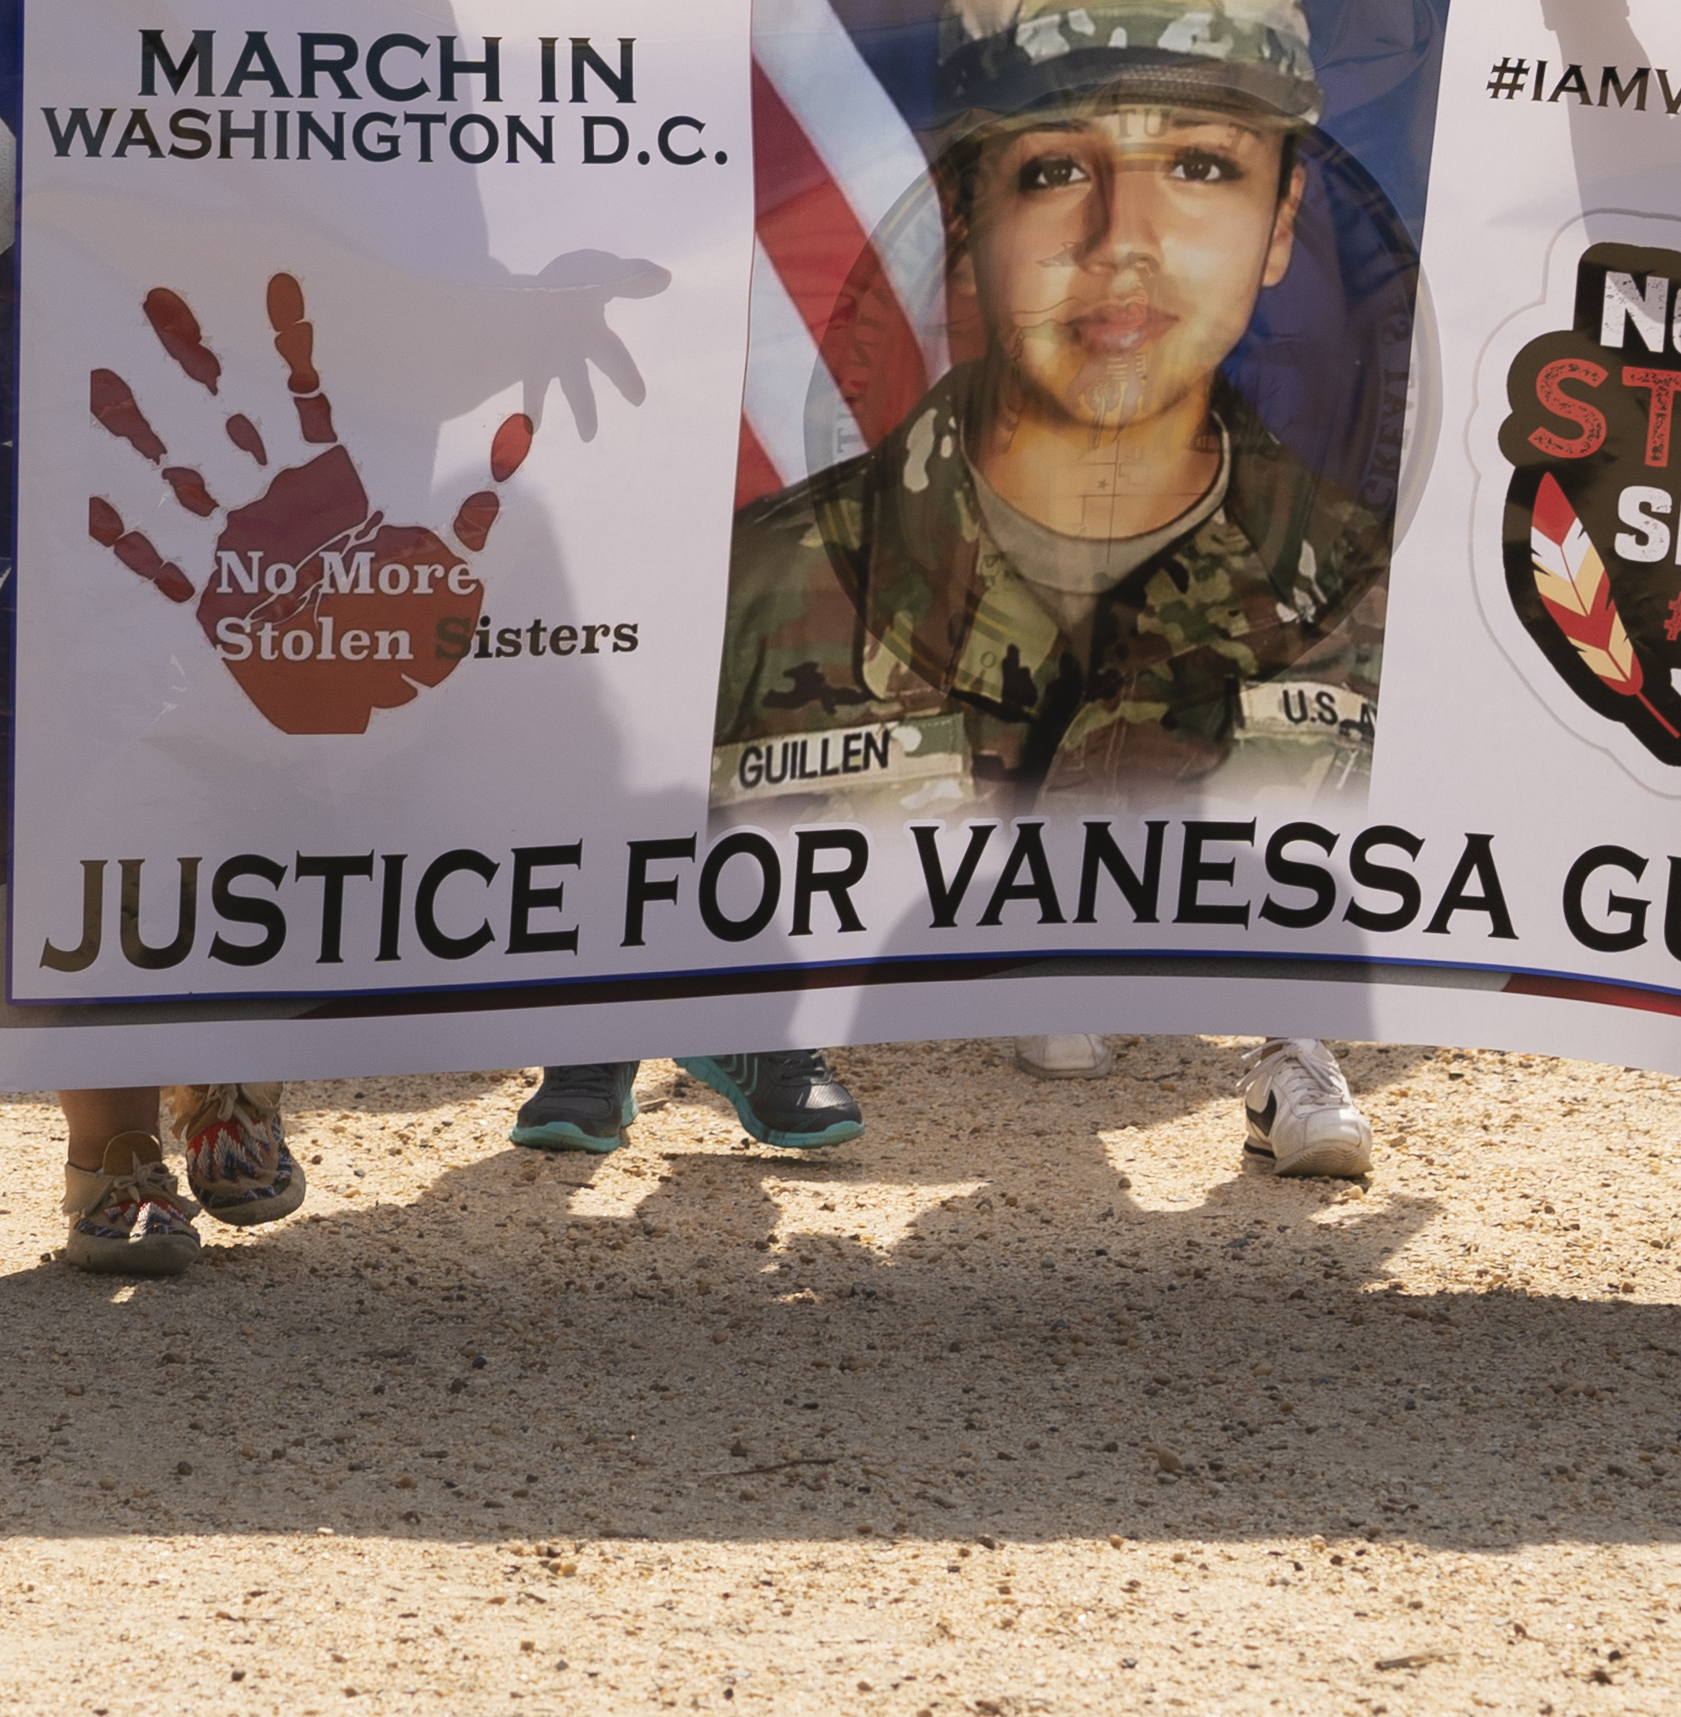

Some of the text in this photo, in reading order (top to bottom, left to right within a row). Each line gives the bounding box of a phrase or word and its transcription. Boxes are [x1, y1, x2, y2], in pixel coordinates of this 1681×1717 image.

[138, 29, 637, 104] MARCH IN
[40, 107, 729, 166] WASHINGTON D.C.
[215, 549, 479, 597] No More
[215, 614, 641, 663] Stolen Sisters
[737, 727, 892, 791] GUILLEN
[38, 838, 585, 973] JUSTICE
[619, 829, 871, 950] FOR
[908, 816, 1519, 941] VANESSA
